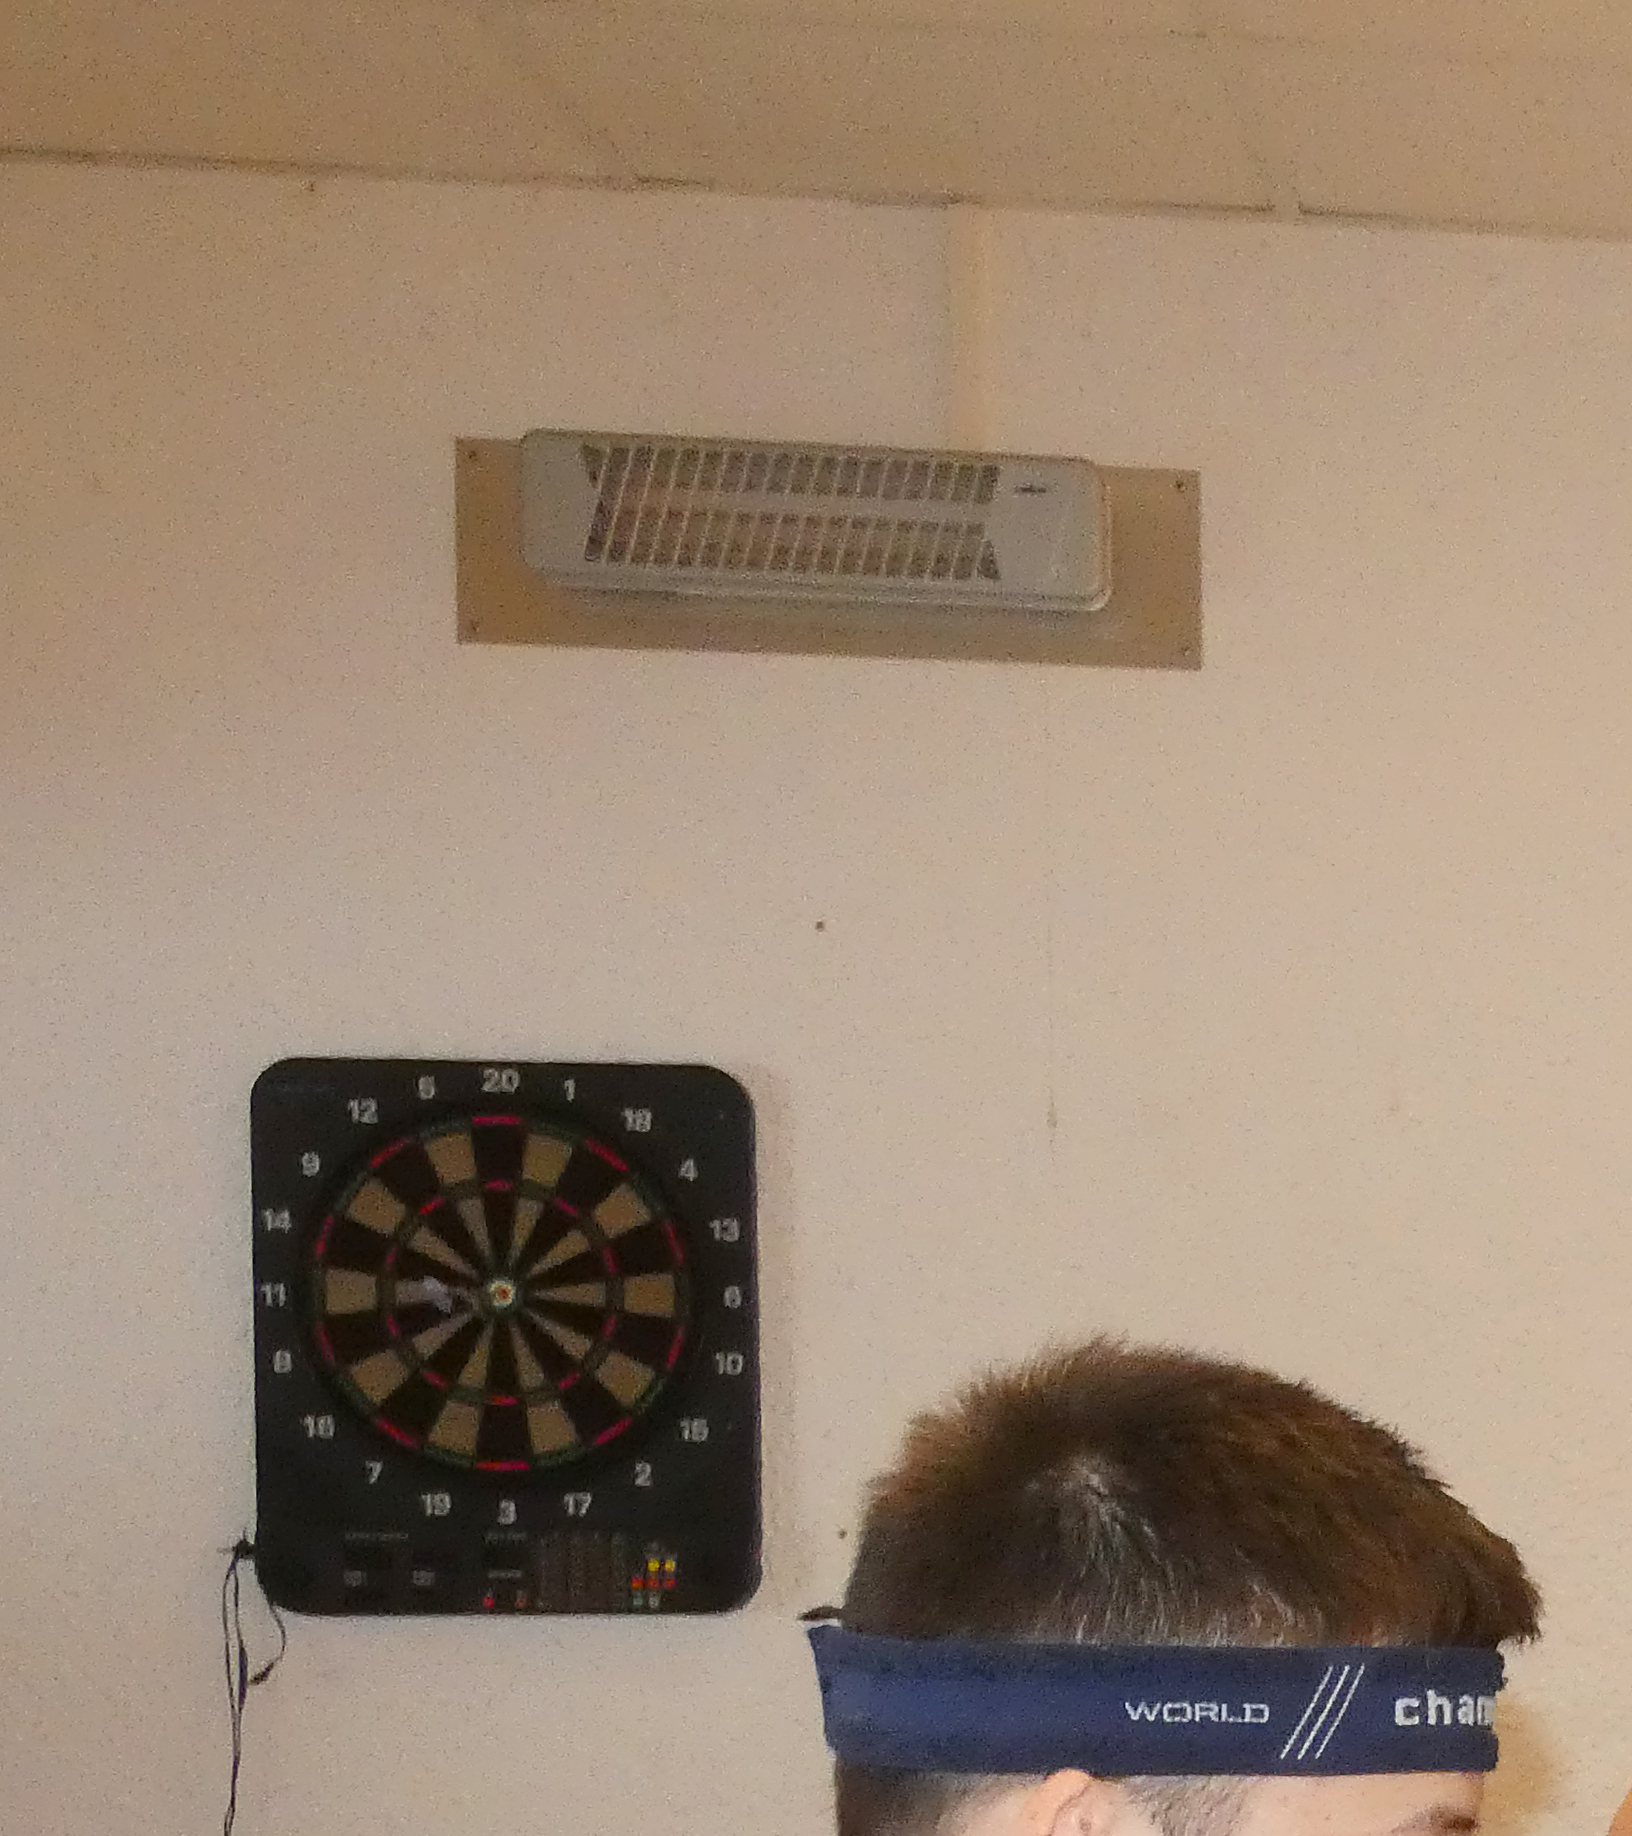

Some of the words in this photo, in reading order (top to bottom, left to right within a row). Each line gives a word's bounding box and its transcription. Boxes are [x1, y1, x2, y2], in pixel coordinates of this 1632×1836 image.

[482, 1068, 520, 1092] 20
[564, 1079, 575, 1101] 1
[348, 1099, 377, 1123] 12
[680, 1159, 697, 1181] 4
[263, 1209, 292, 1231] 14
[710, 1218, 740, 1242] 13
[260, 1283, 287, 1307] 11
[715, 1353, 744, 1375] 10
[366, 1461, 383, 1484] 7
[635, 1463, 652, 1486] 2
[421, 1493, 451, 1515] 19
[499, 1501, 516, 1524] 3
[564, 1493, 592, 1515] 17
[1123, 1700, 1270, 1725] WORLD
